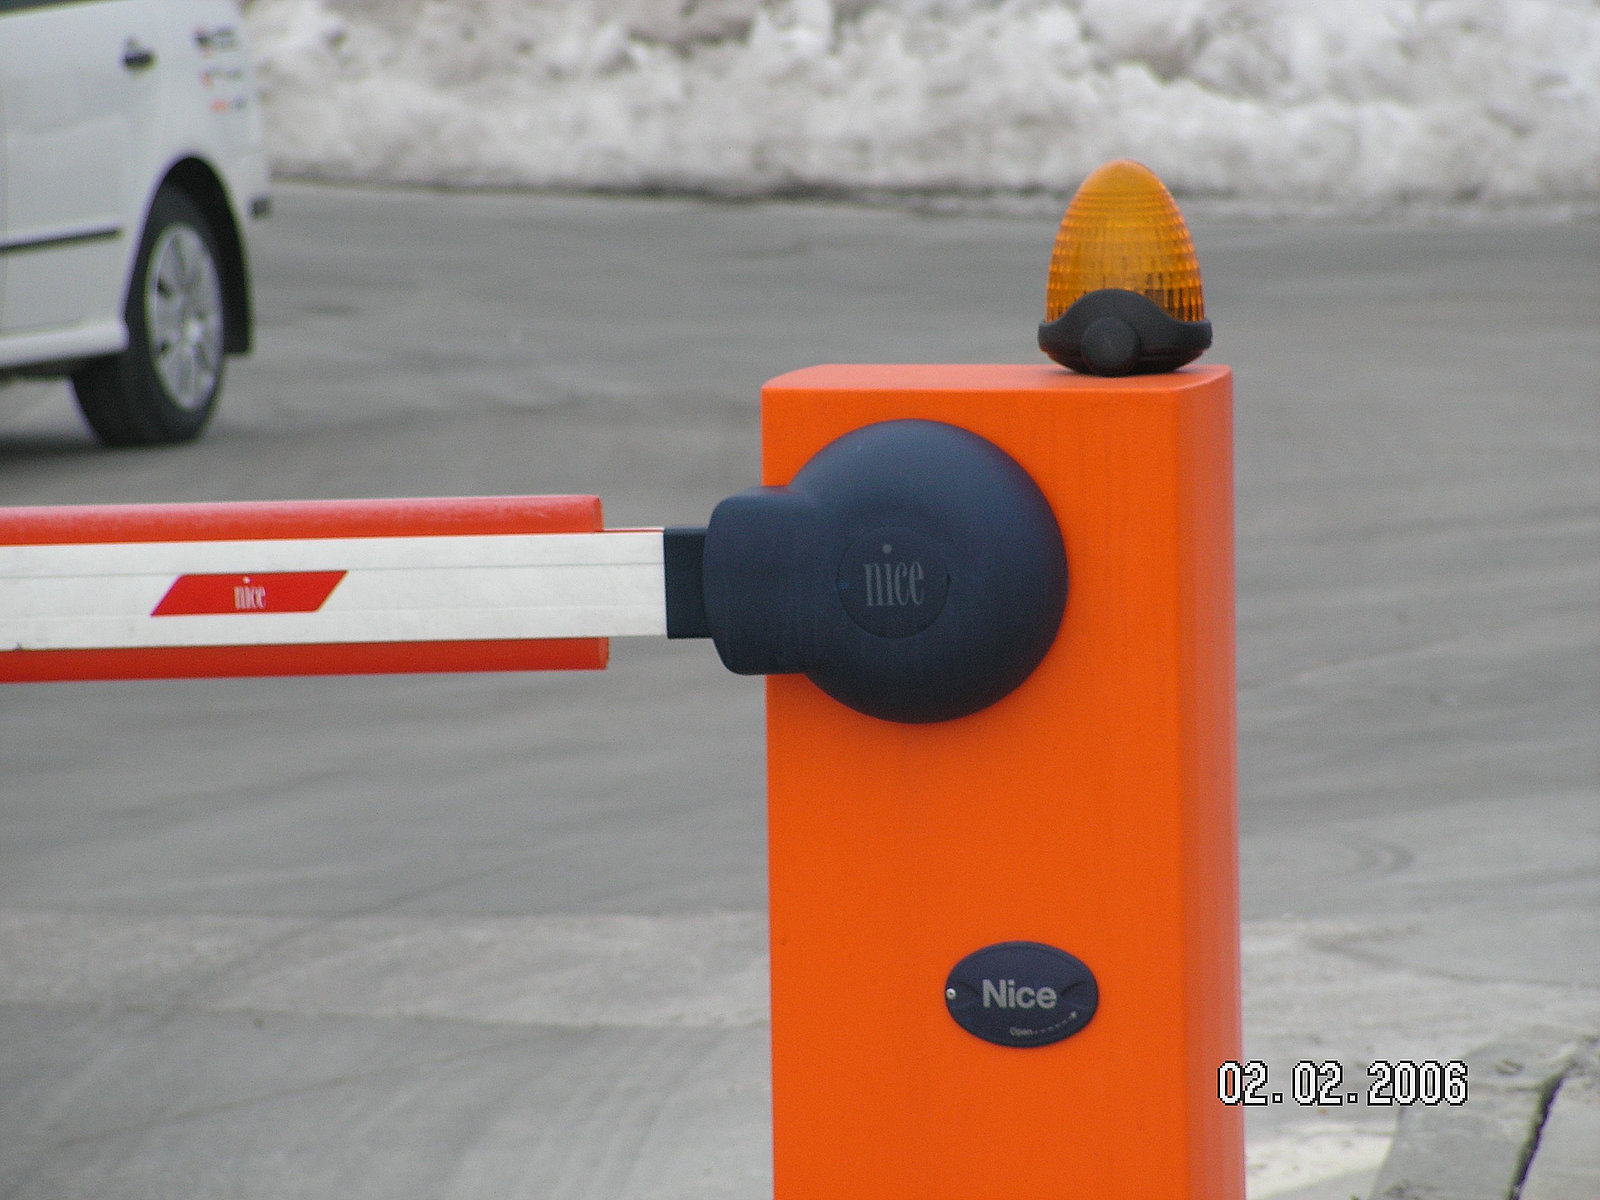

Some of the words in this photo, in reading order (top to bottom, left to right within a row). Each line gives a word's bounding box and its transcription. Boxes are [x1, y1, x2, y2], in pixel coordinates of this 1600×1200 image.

[863, 543, 924, 607] nice
[234, 576, 266, 609] nice
[982, 978, 1058, 1010] Nice
